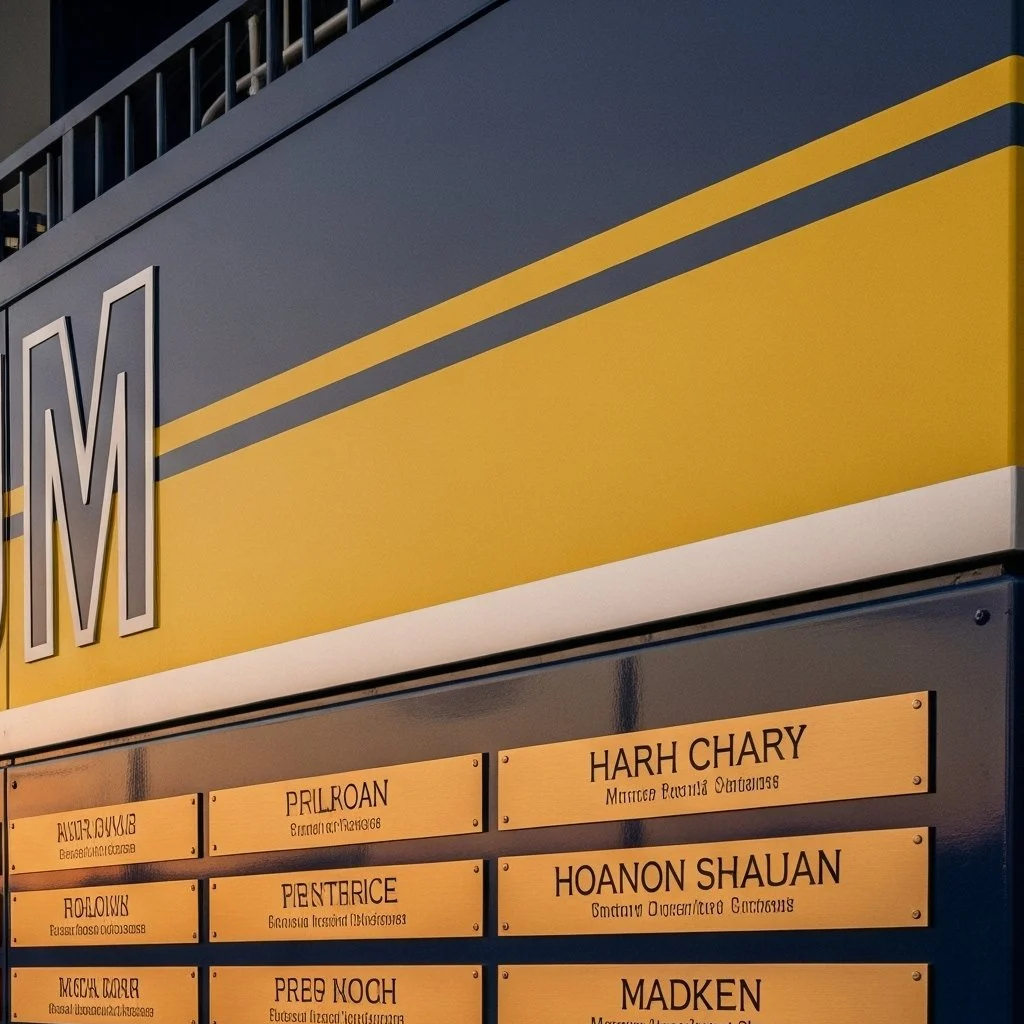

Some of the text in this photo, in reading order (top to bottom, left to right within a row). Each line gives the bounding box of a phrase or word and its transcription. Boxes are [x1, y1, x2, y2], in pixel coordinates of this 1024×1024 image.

[590, 724, 807, 783] HARH CHARY
[555, 849, 842, 897] HOANON SHAUAN
[621, 978, 761, 1012] MADKEN
